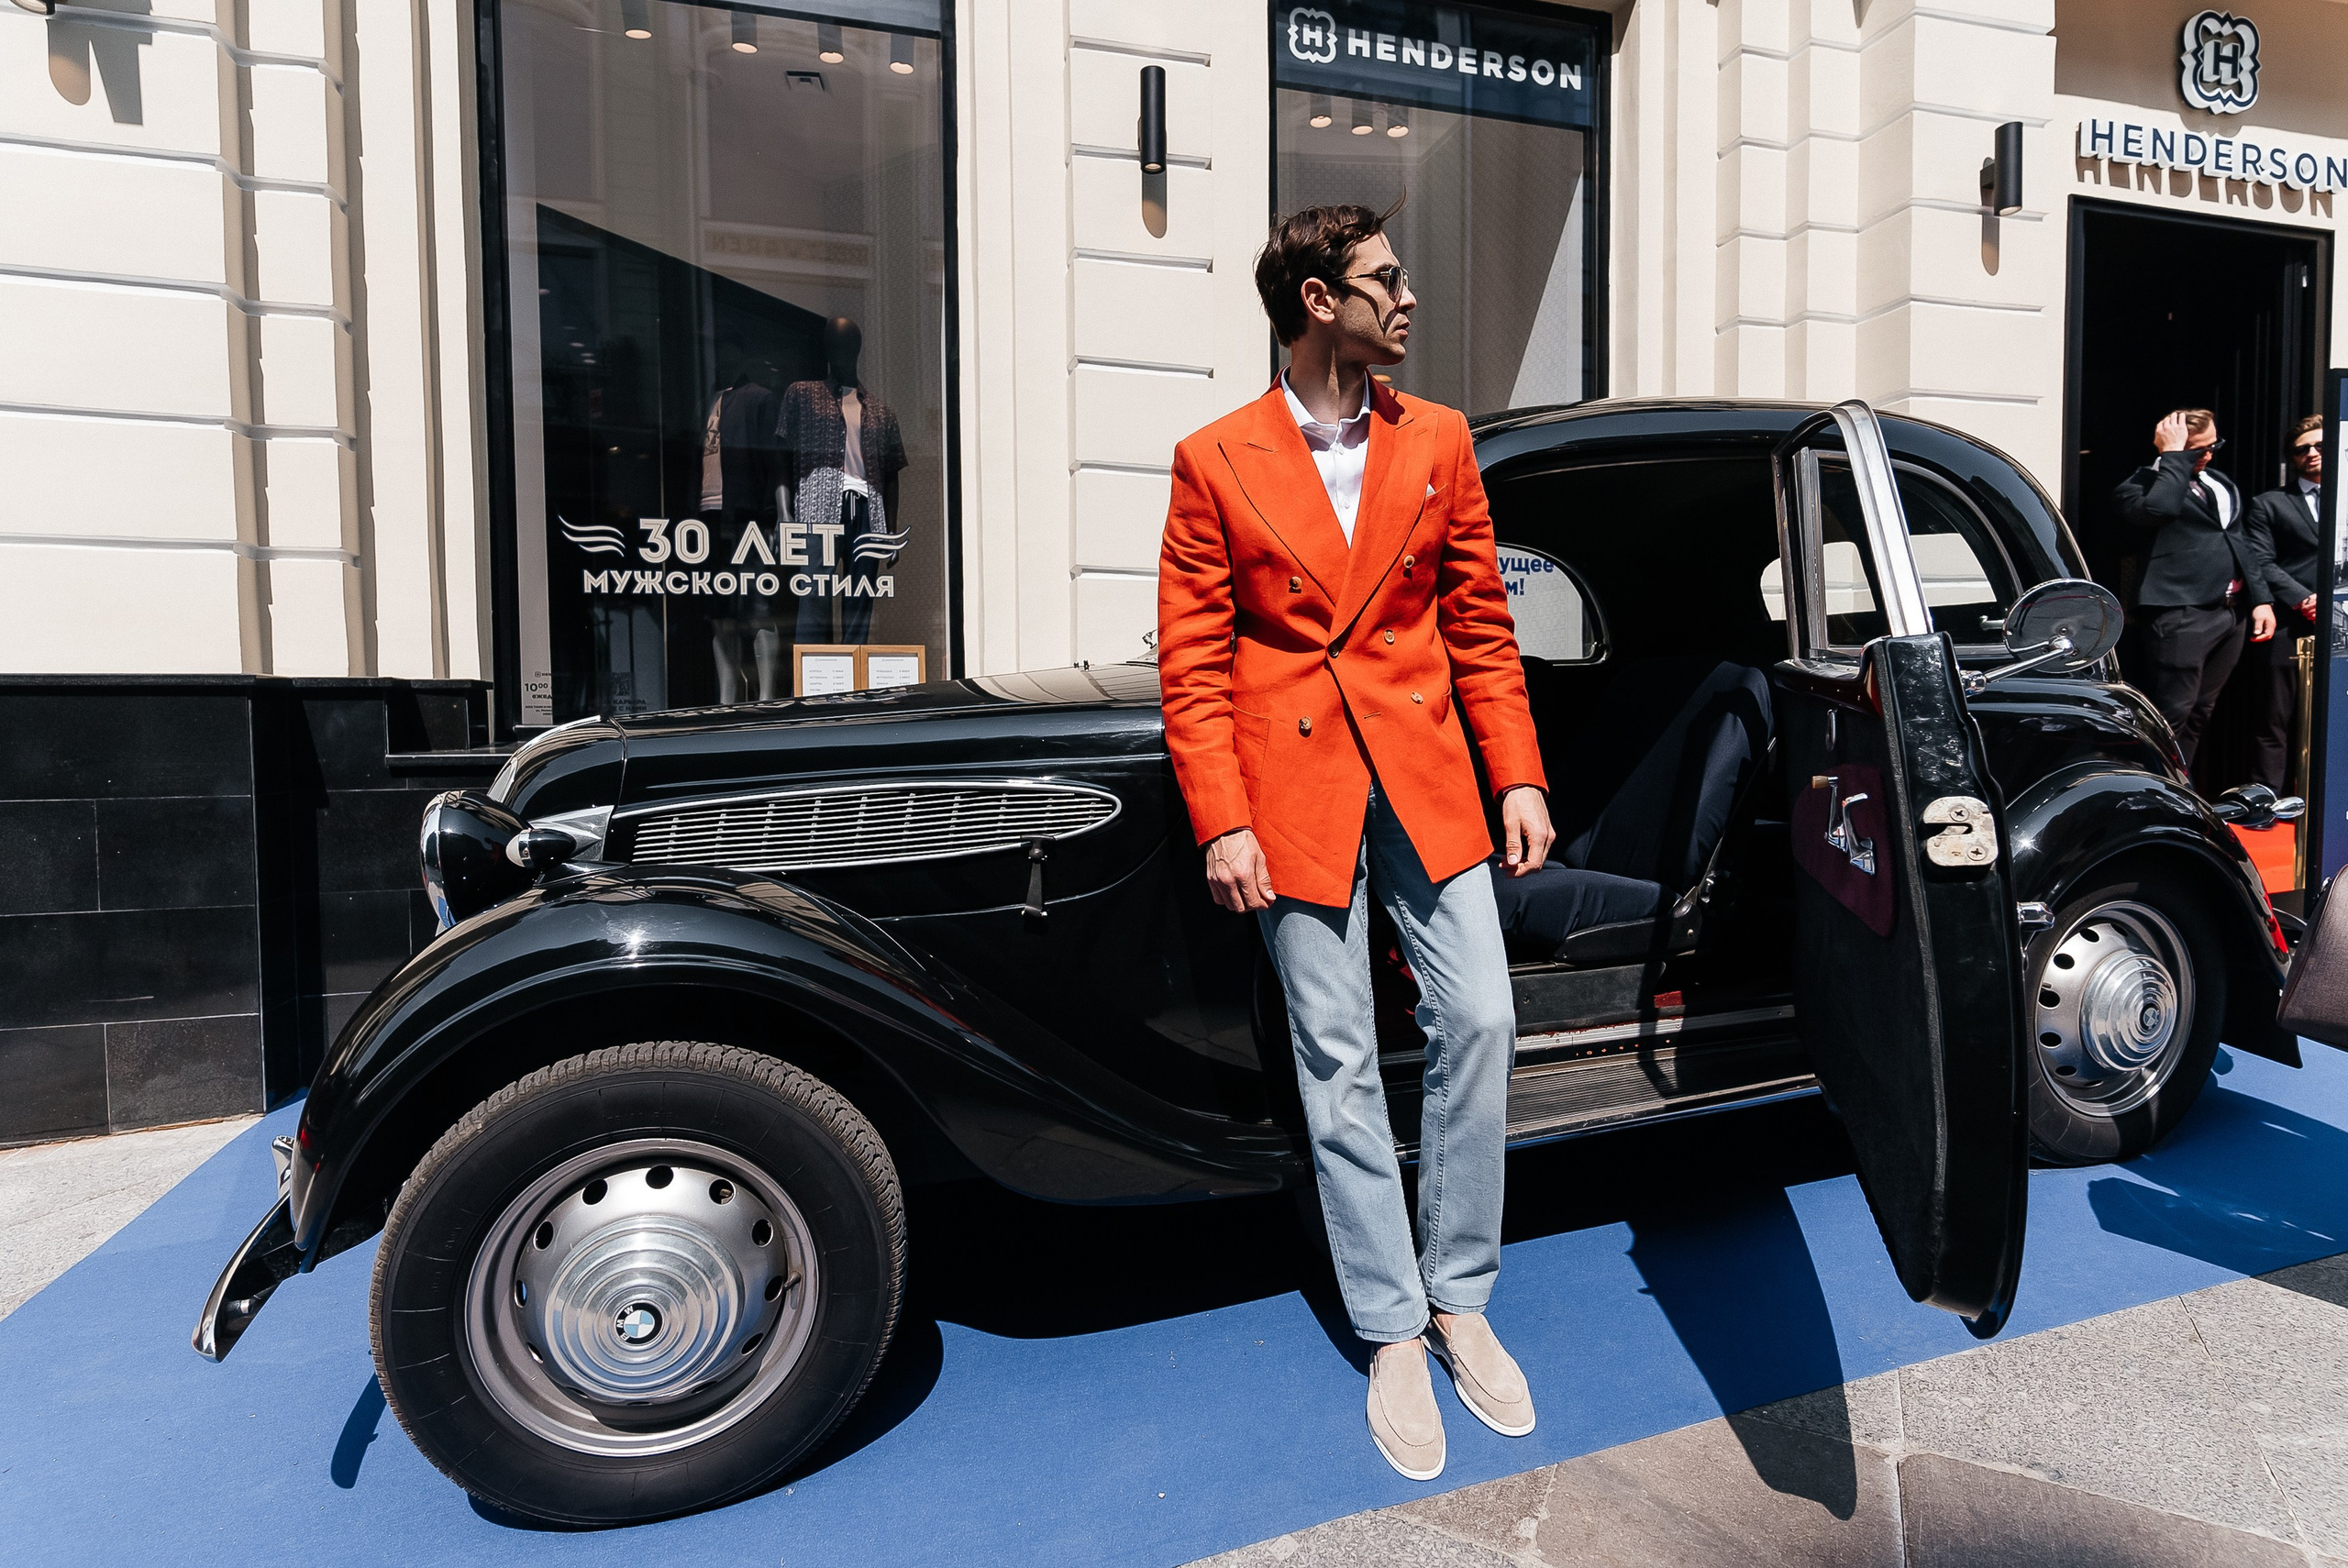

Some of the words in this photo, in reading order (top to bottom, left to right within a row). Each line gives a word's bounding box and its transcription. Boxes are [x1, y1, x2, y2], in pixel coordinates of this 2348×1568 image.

[1301, 23, 1324, 48] H
[1346, 28, 1583, 91] HENDERSON
[2209, 39, 2241, 82] H
[2088, 117, 2348, 190] HENDERSON
[638, 517, 710, 565] 30
[731, 520, 846, 567] ЛЕТ
[582, 569, 781, 597] МУЖСКОГО
[789, 571, 895, 599] СТИЛЯ
[1498, 556, 1555, 576] ущее
[1504, 578, 1525, 596] м!
[616, 1305, 635, 1342] BMW
